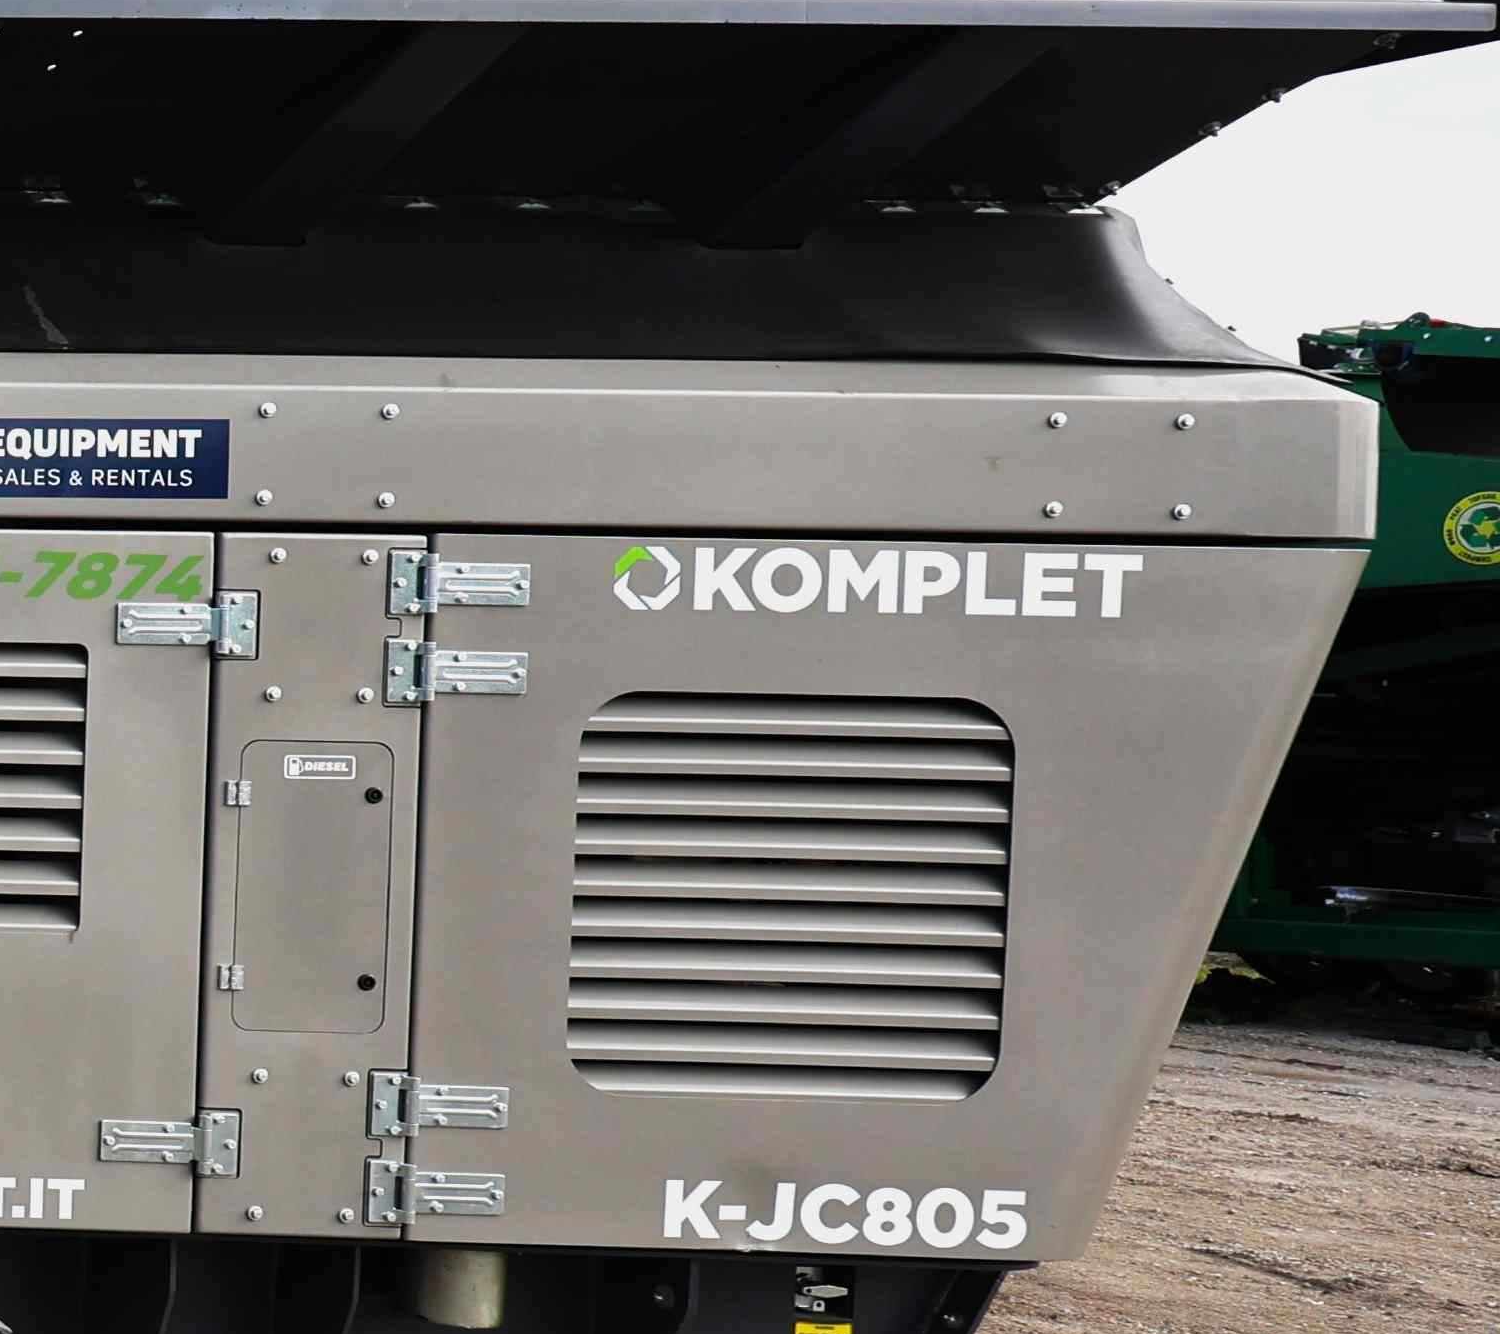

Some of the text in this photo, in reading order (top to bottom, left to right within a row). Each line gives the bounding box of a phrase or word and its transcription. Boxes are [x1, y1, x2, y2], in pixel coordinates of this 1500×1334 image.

[69, 469, 83, 486] &
[91, 468, 193, 487] RENTALS
[693, 547, 1144, 618] KOMPLET
[304, 761, 349, 772] DIESEL
[663, 1179, 1027, 1249] K-JC805
